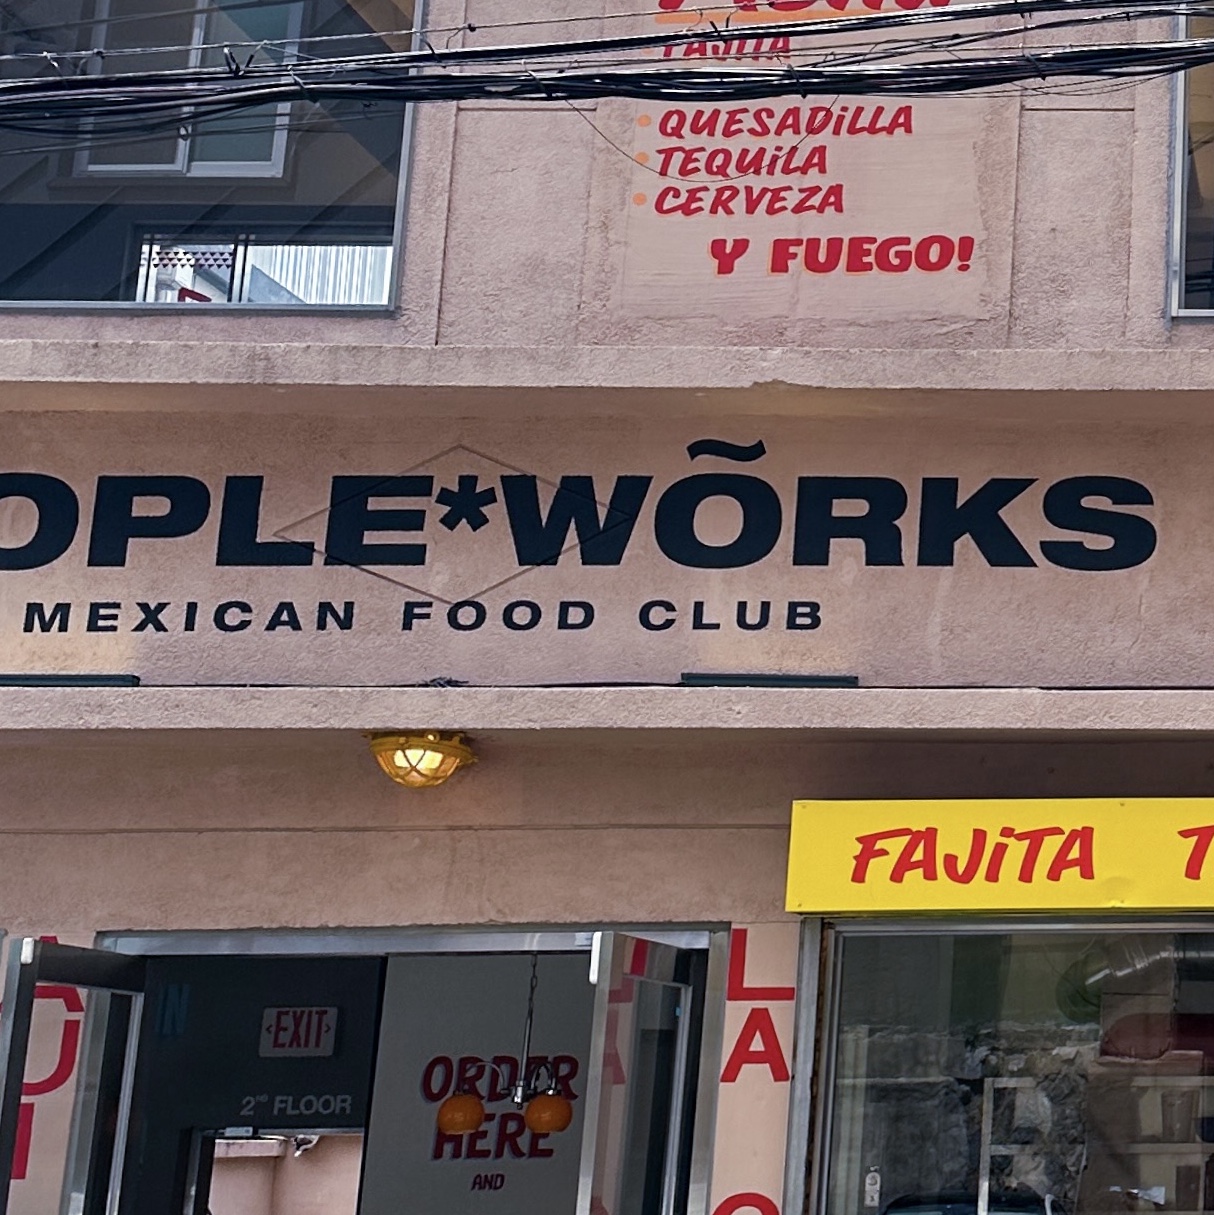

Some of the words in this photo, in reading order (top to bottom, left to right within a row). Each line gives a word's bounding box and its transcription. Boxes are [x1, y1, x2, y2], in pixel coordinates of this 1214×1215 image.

[655, 184, 843, 216] CERVEZA
[710, 238, 749, 275] Y
[770, 235, 975, 275] FUEGO!
[22, 600, 355, 633] MEXICAN
[401, 599, 597, 632] FOOD
[638, 599, 823, 632] CLUB
[720, 928, 795, 1082] LA
[272, 1010, 328, 1049] EXIT
[421, 1055, 579, 1102] ORDER
[273, 1095, 351, 1116] FLOOR
[433, 1113, 556, 1160] HERE
[471, 1173, 505, 1191] AND
